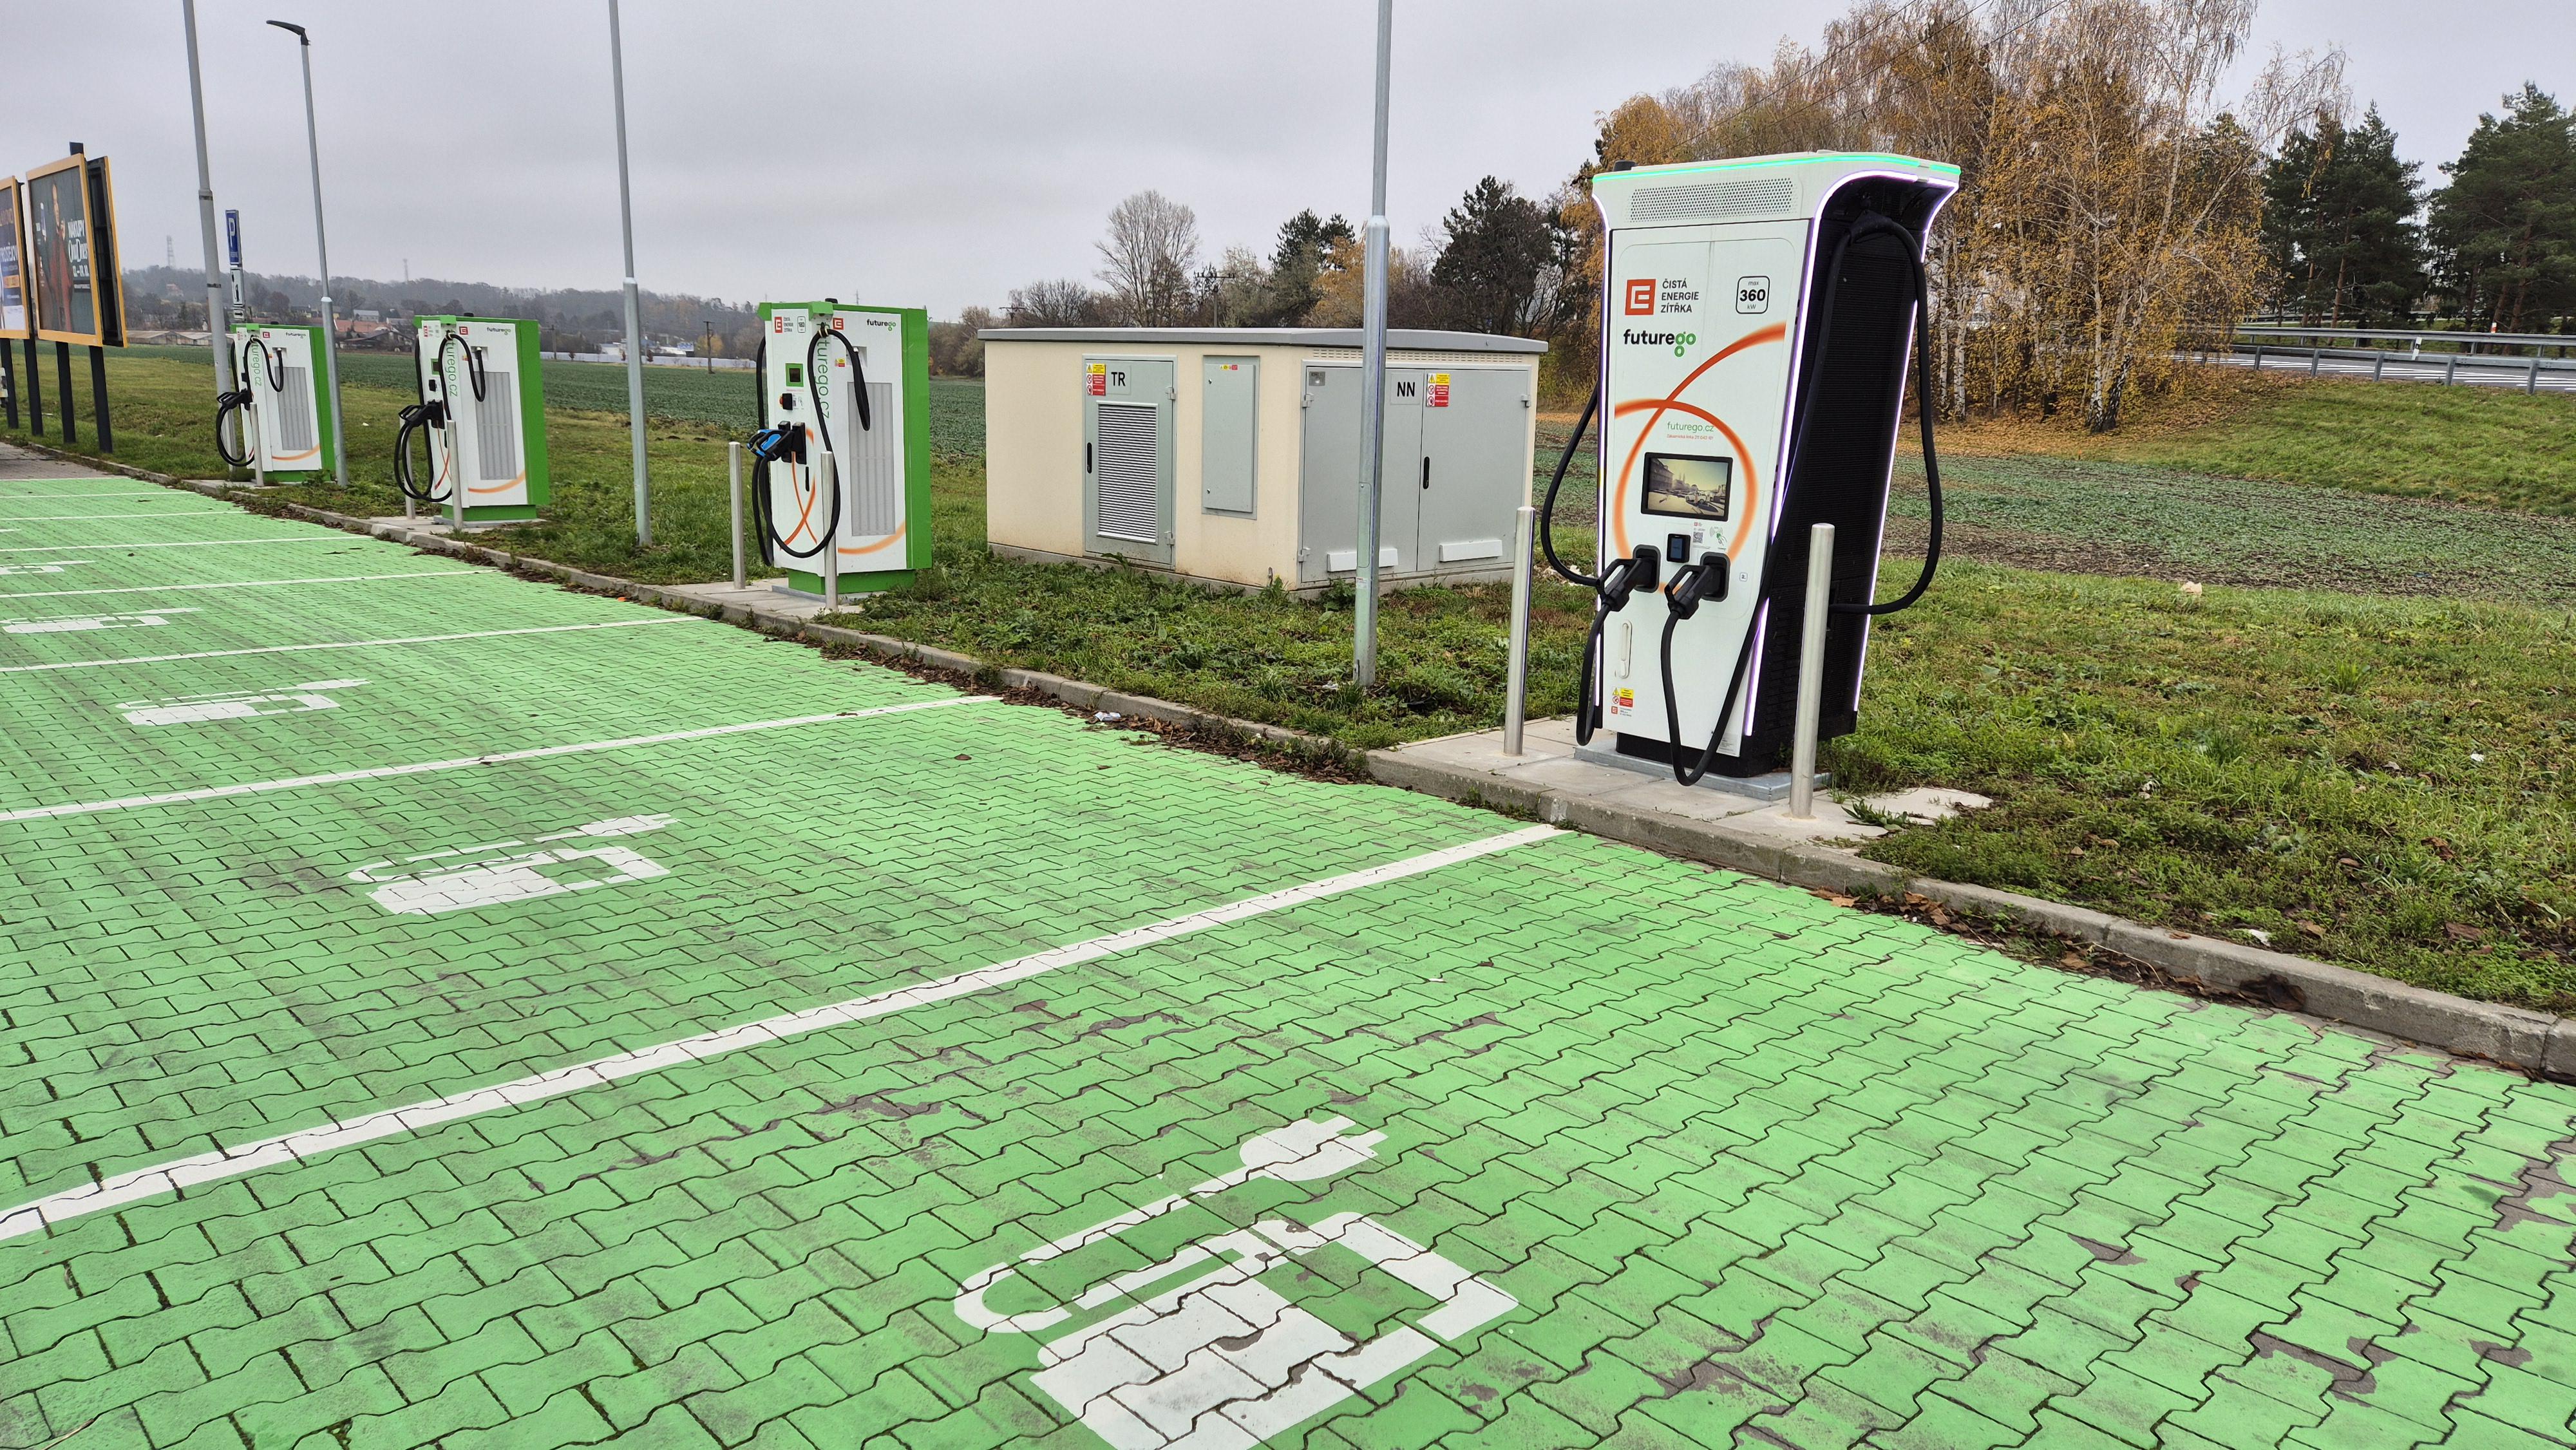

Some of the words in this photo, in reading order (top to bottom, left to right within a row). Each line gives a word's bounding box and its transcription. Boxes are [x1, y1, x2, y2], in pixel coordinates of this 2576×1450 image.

[1662, 278, 1687, 288] ČISTÁ
[1662, 292, 1700, 301] ENERGIE
[1739, 289, 1766, 302] 360
[1661, 303, 1692, 313] ZÍTŘKA
[867, 319, 896, 331] futurego
[1624, 328, 1696, 357] futurego
[1111, 372, 1126, 386] TR
[1397, 382, 1416, 397] NN
[1667, 421, 1714, 433] futurego.cz
